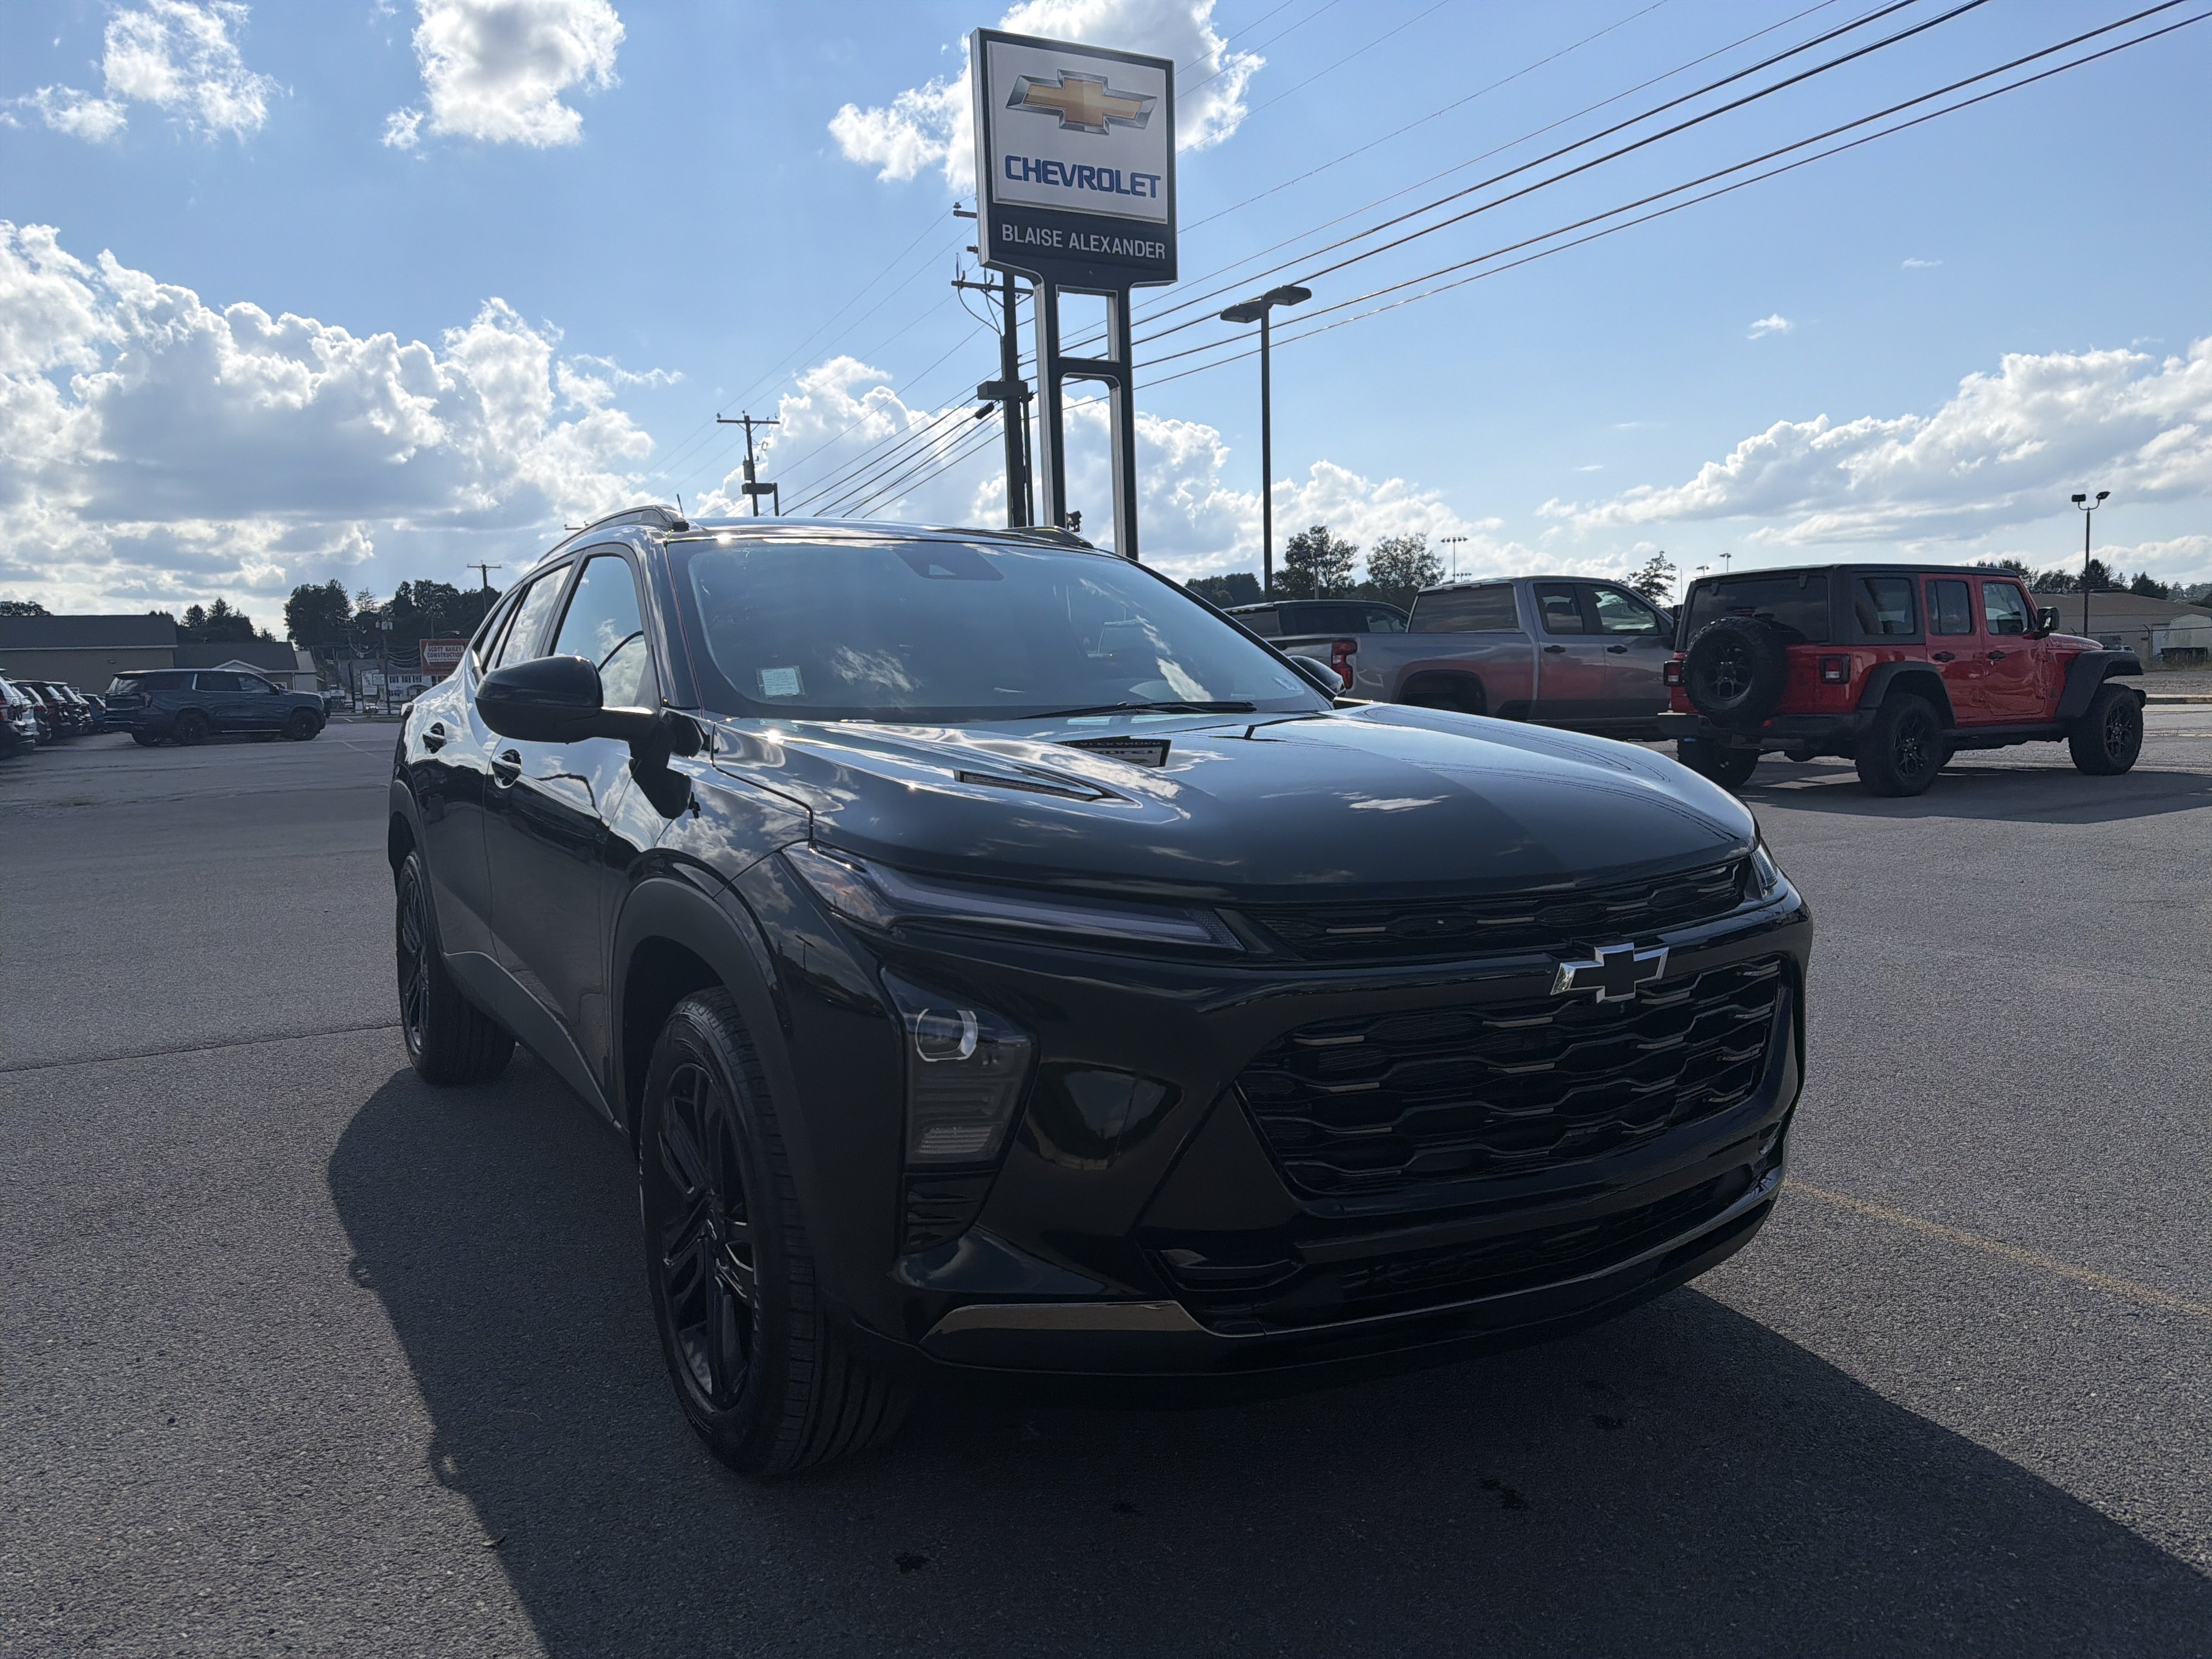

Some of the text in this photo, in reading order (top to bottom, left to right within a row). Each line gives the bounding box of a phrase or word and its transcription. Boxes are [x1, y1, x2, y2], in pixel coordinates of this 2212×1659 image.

[1005, 155, 1161, 198] CHEVROLET
[1002, 224, 1166, 259] BLAISE ALEXANDER
